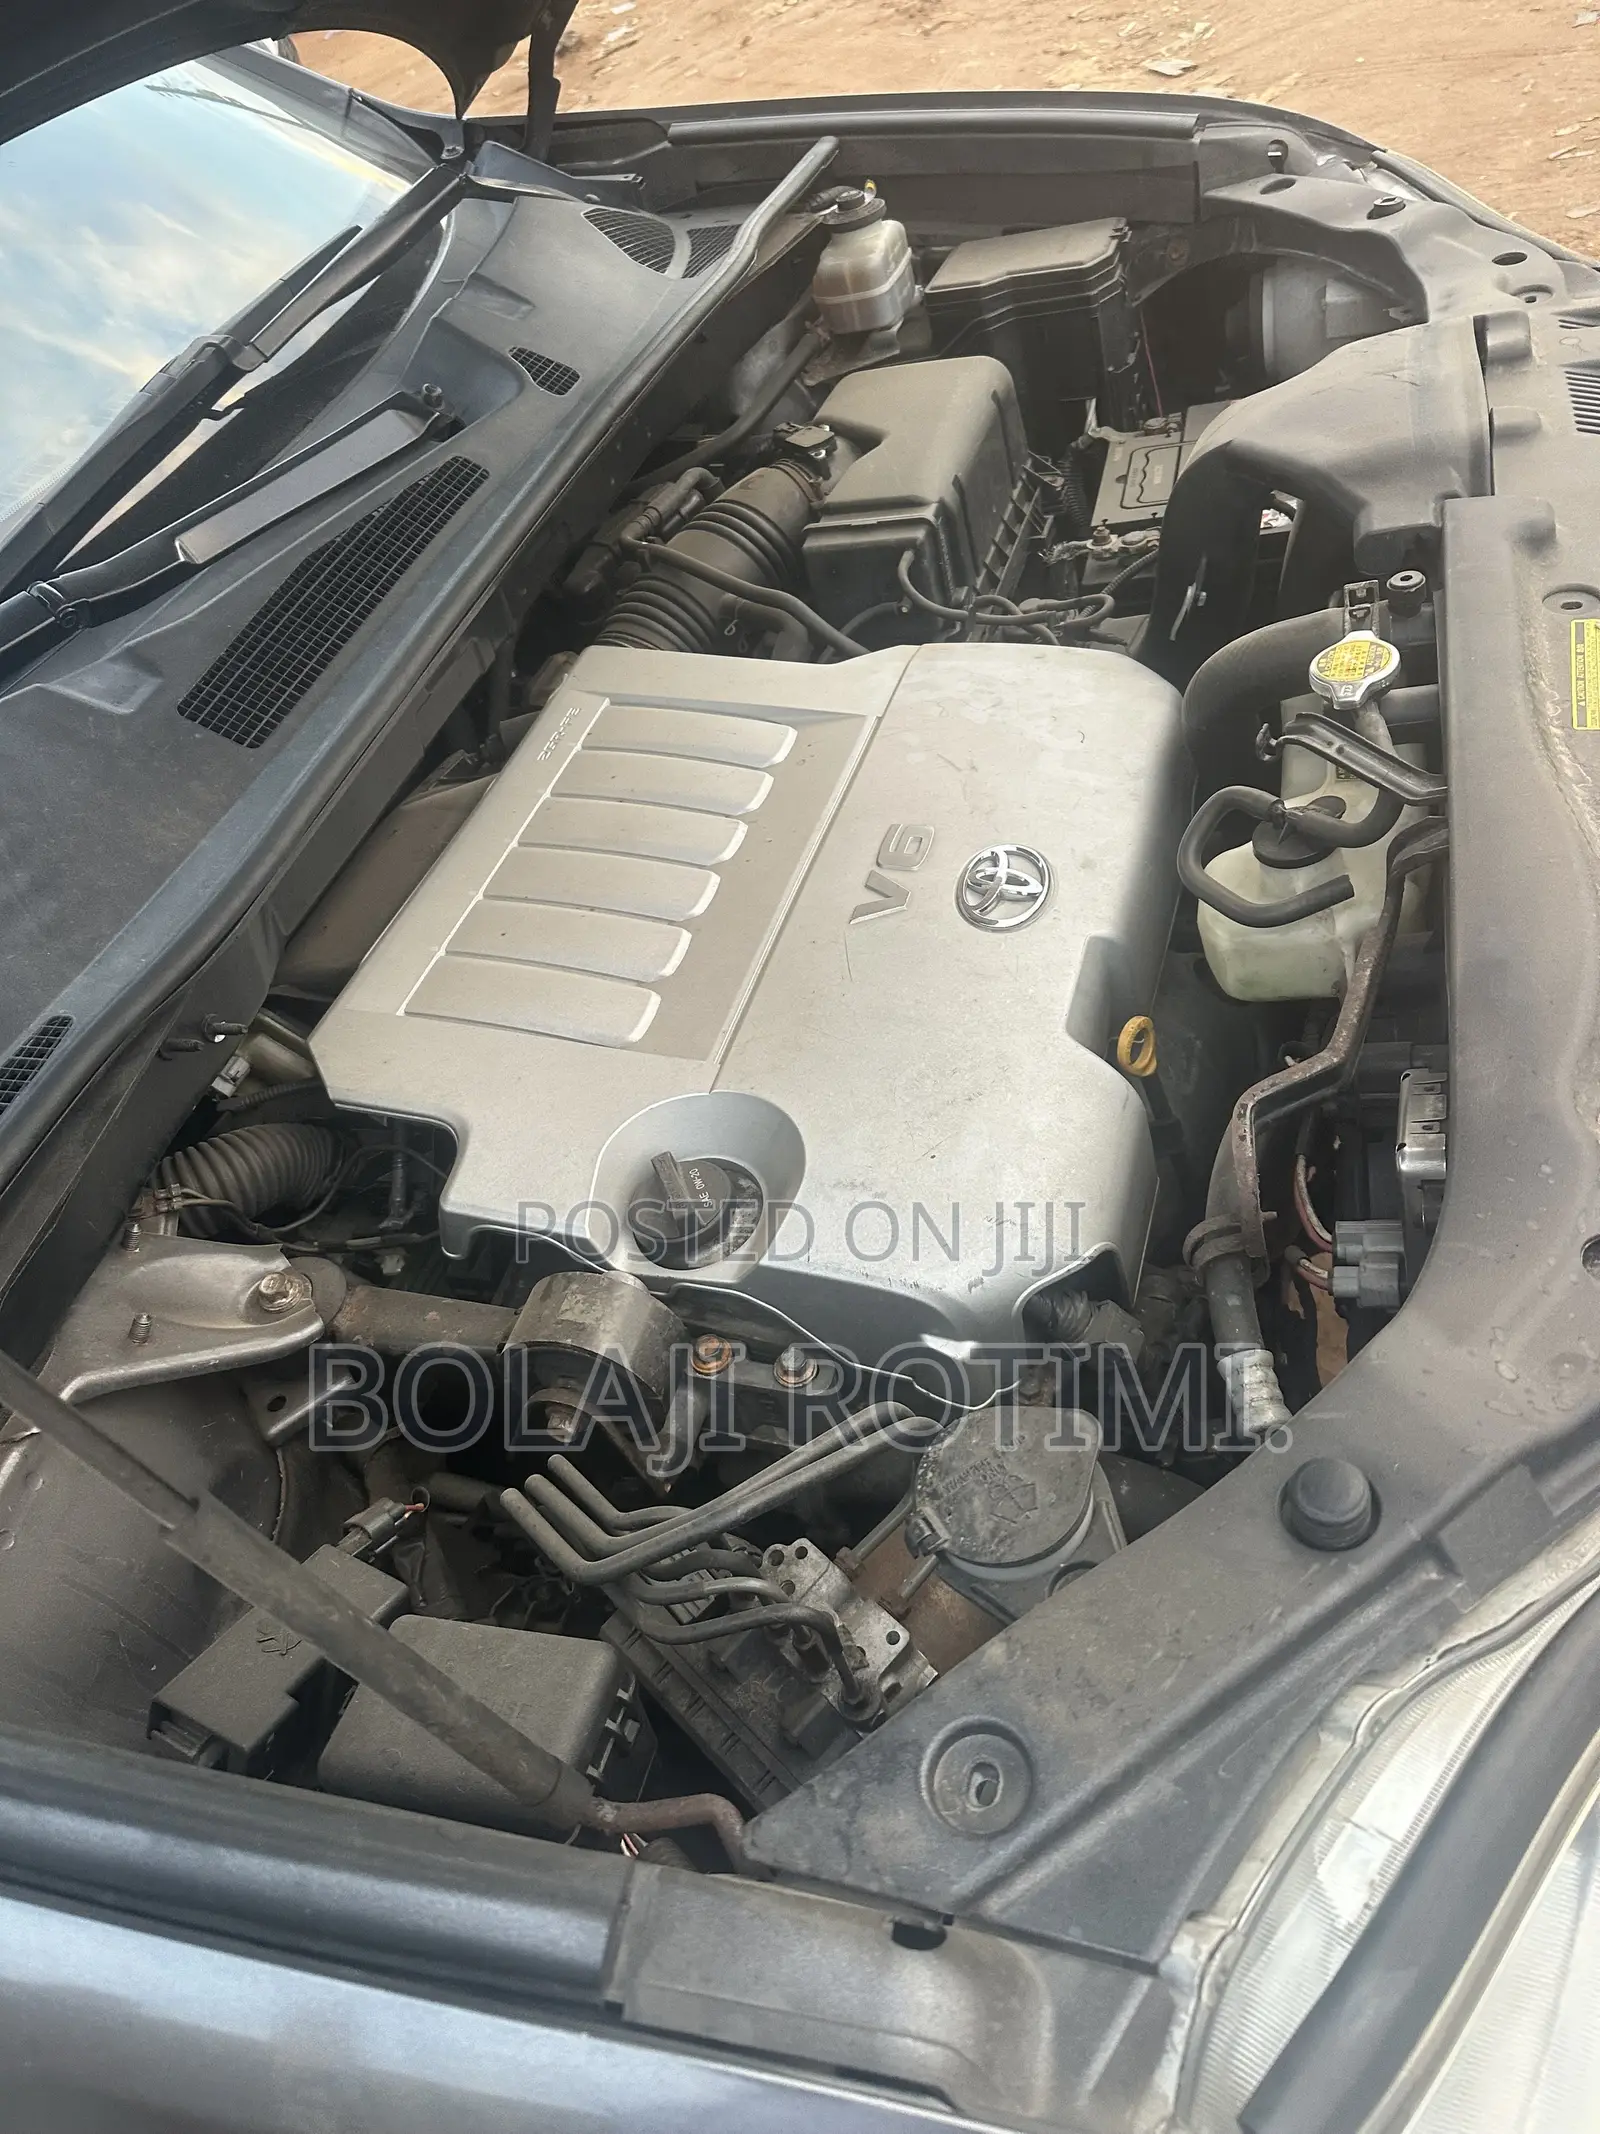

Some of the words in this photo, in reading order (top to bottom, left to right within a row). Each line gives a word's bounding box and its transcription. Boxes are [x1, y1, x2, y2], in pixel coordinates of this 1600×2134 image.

[537, 707, 581, 761] 2GR-FE
[848, 823, 935, 925] V6
[688, 1168, 705, 1190] 0W-20
[699, 1191, 713, 1208] SAE
